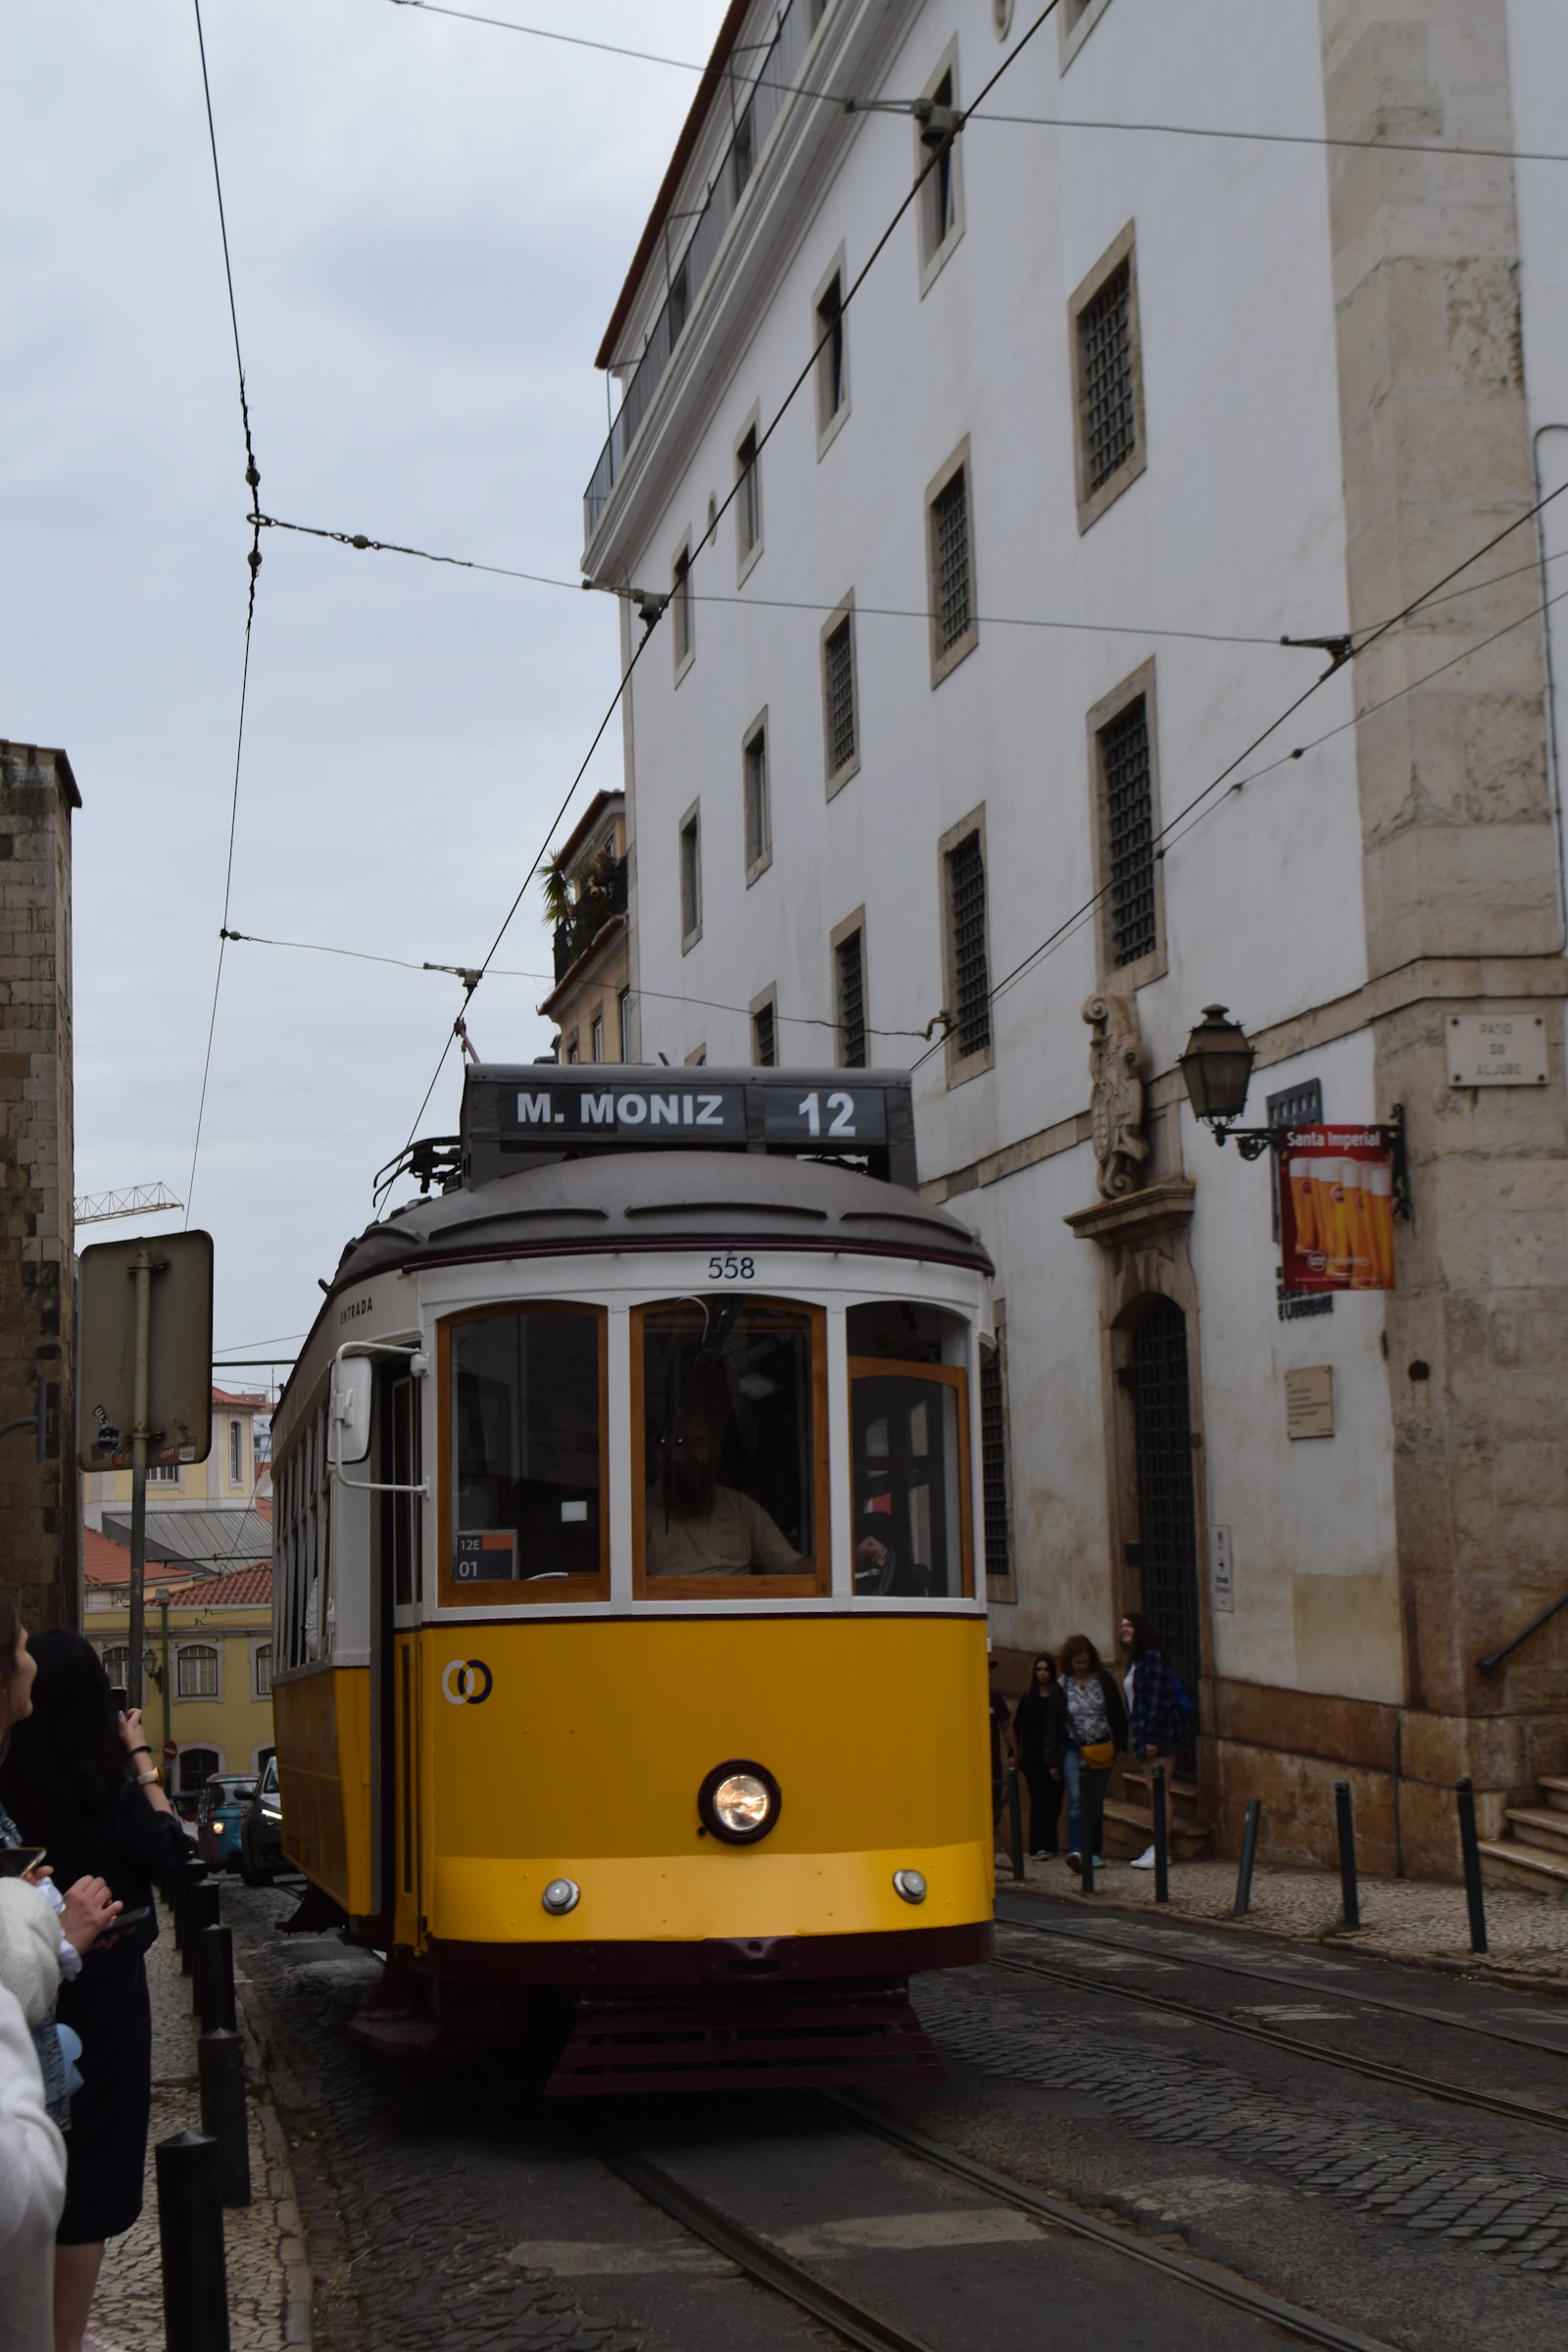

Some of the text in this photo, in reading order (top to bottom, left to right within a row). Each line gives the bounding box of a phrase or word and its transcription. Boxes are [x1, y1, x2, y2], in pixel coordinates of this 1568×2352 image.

[1490, 1043, 1506, 1055] DO
[1476, 1062, 1521, 1076] ALJUBE
[516, 1093, 724, 1125] M. MONIZ
[798, 1092, 857, 1138] 12
[1287, 1131, 1381, 1151] Santa Imperial
[708, 1256, 756, 1280] 558
[340, 1297, 373, 1326] ENTRADA
[460, 1540, 481, 1551] 12E
[459, 1560, 478, 1578] 01
